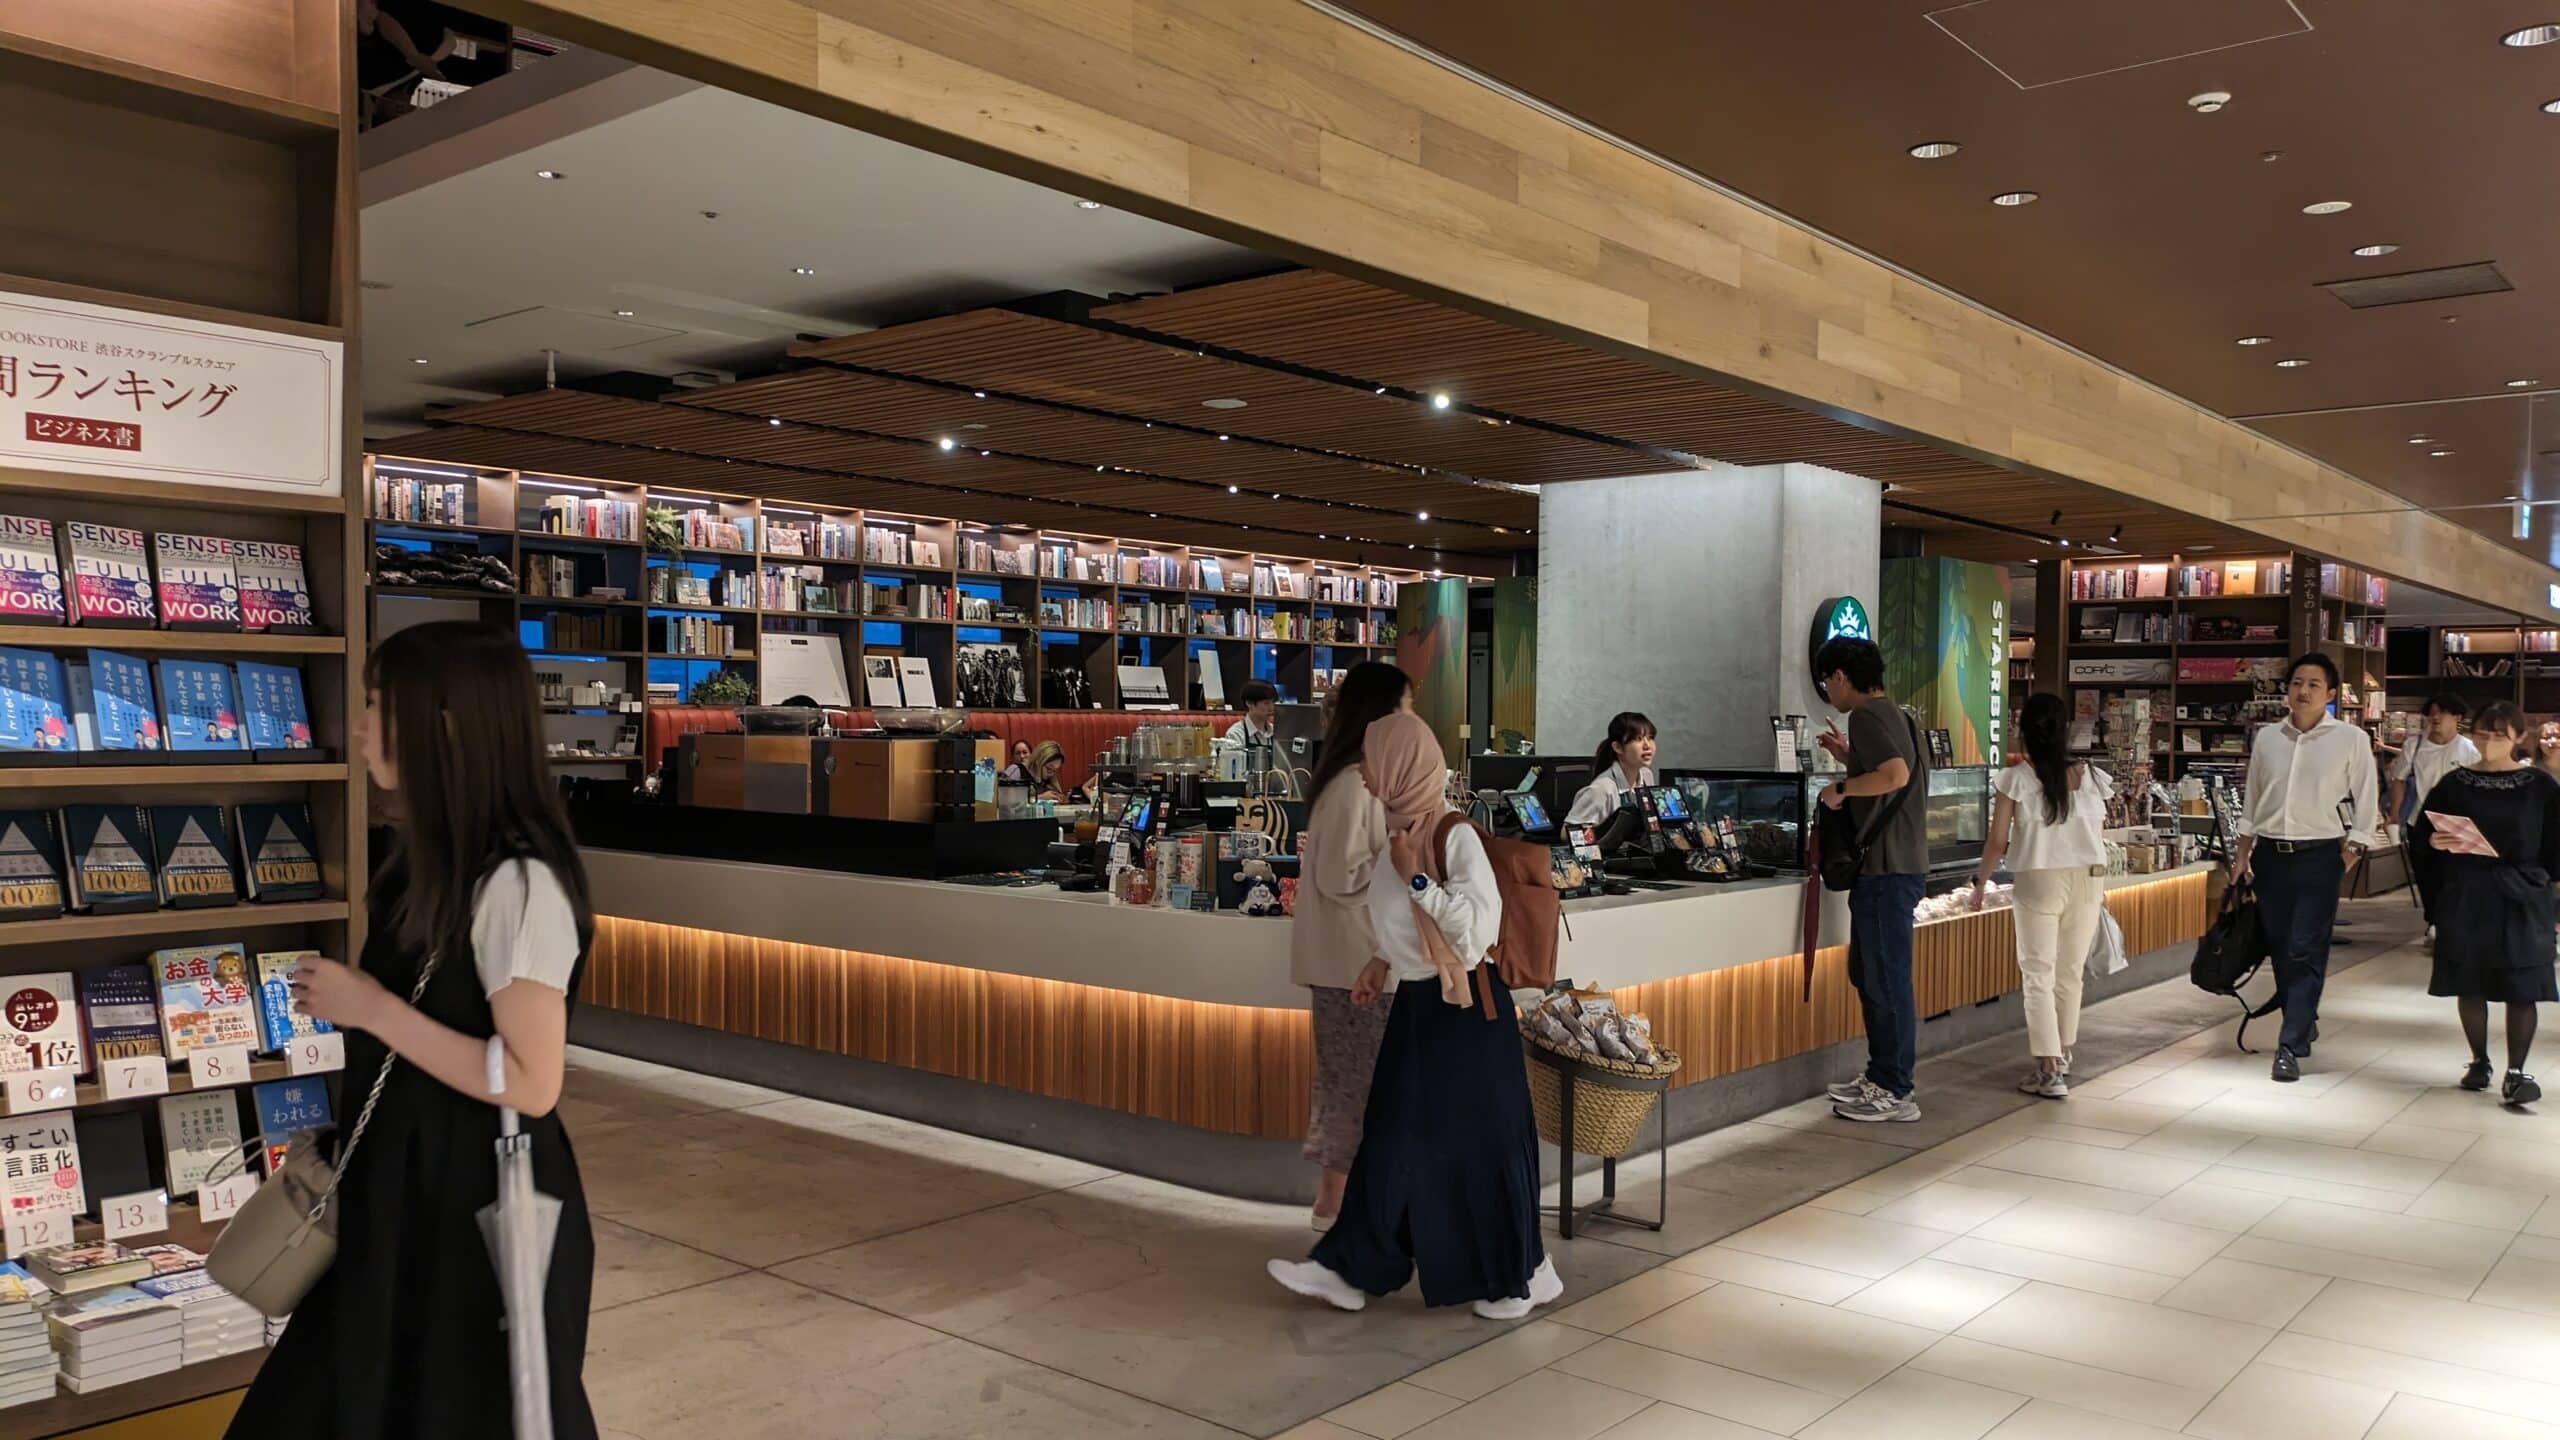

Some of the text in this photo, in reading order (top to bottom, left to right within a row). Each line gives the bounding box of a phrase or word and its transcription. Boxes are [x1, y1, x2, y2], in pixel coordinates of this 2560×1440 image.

[95, 342, 237, 372] 渋谷スクランブルスクエア
[34, 418, 135, 448] ビジネス書
[0, 517, 53, 538] NSE
[70, 523, 145, 548] SENSE
[158, 534, 232, 555] SENSE
[233, 541, 301, 561] SENSE
[76, 559, 149, 583] FULL
[162, 568, 237, 588] FULL
[239, 575, 308, 594] FULL
[81, 594, 157, 618] WORK
[163, 601, 240, 622] WORK
[245, 607, 313, 626] WORK
[1989, 599, 2004, 790] STARBUC
[164, 957, 211, 981] お金
[200, 977, 213, 987] の
[202, 983, 247, 1007] 大学
[26, 1041, 80, 1070] 1位
[306, 1045, 319, 1065] 9
[122, 1067, 137, 1089] 7
[207, 1057, 221, 1078] 8
[28, 1080, 44, 1102] 6
[273, 1104, 323, 1124] われる
[1, 1128, 70, 1154] すごい
[5, 1149, 74, 1179] 言語化
[211, 1188, 236, 1211] 14
[114, 1204, 144, 1230] 13
[18, 1221, 49, 1248] 12
